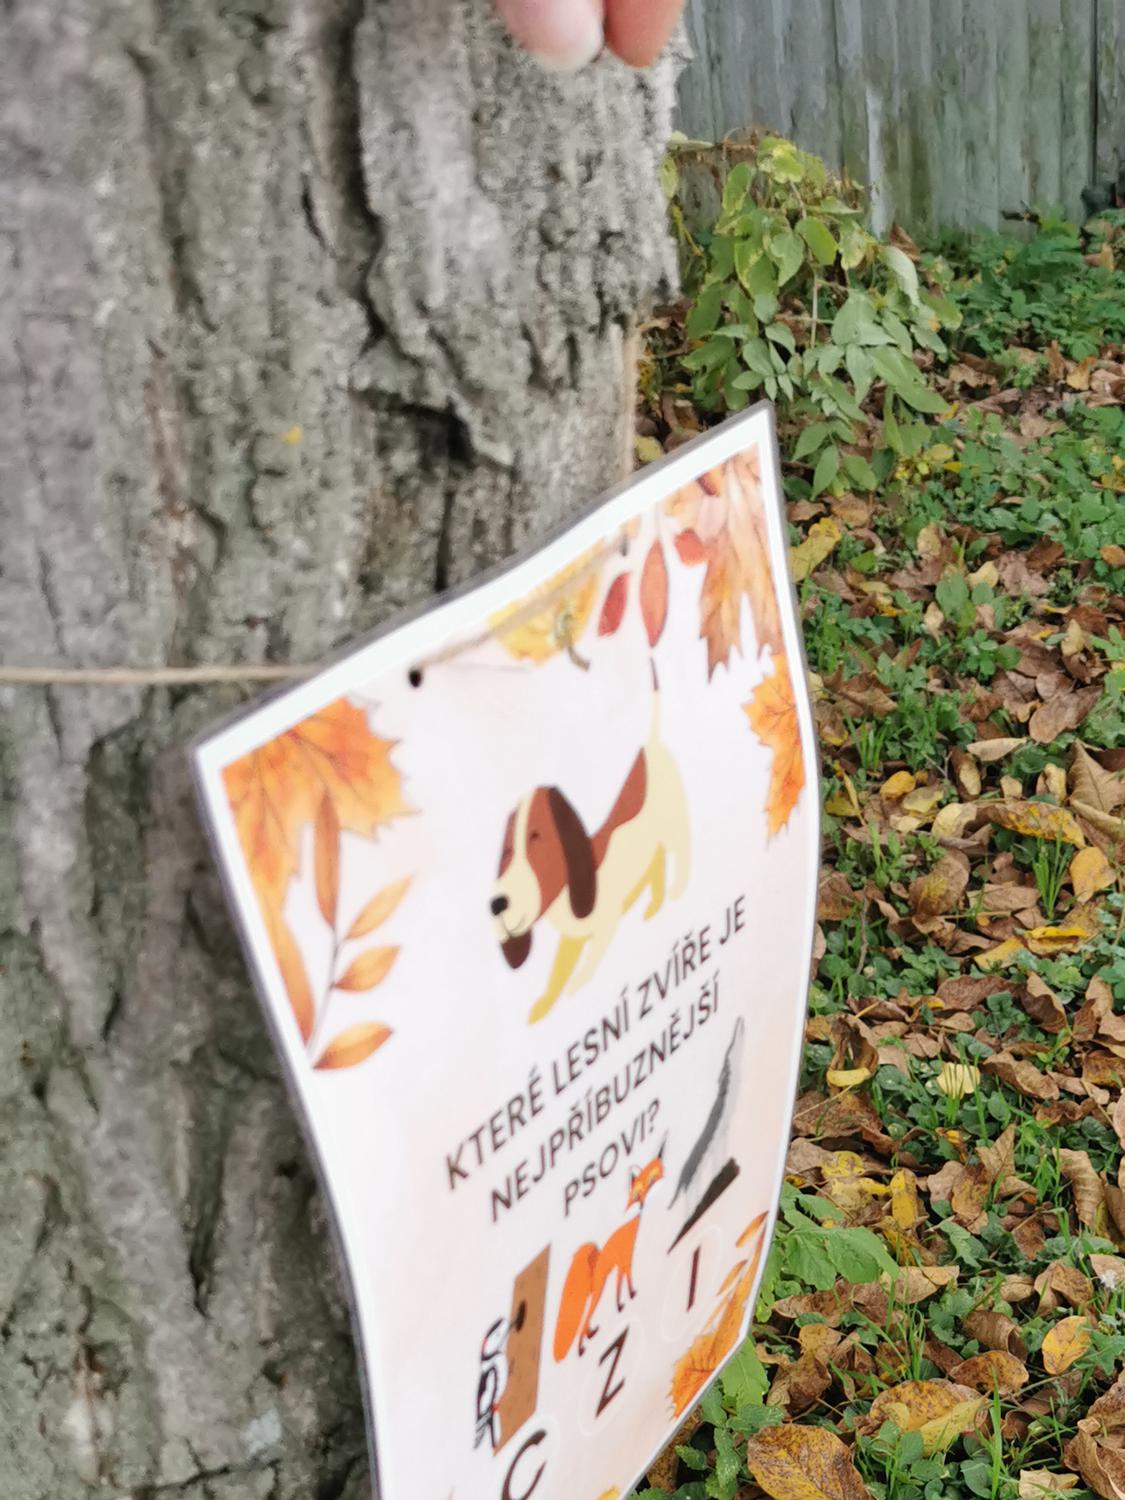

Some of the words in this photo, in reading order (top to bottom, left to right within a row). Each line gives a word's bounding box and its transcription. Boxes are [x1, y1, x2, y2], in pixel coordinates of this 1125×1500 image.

[446, 1066, 543, 1190] KTERÉ
[553, 983, 631, 1094] LESNÍ
[638, 927, 711, 1021] ZVÍŘE
[718, 895, 745, 945] JE
[491, 971, 720, 1222] NEJPŘÍBUZNĚJŠÍ
[564, 1099, 661, 1216] PSOVI?
[595, 1327, 629, 1418] Z
